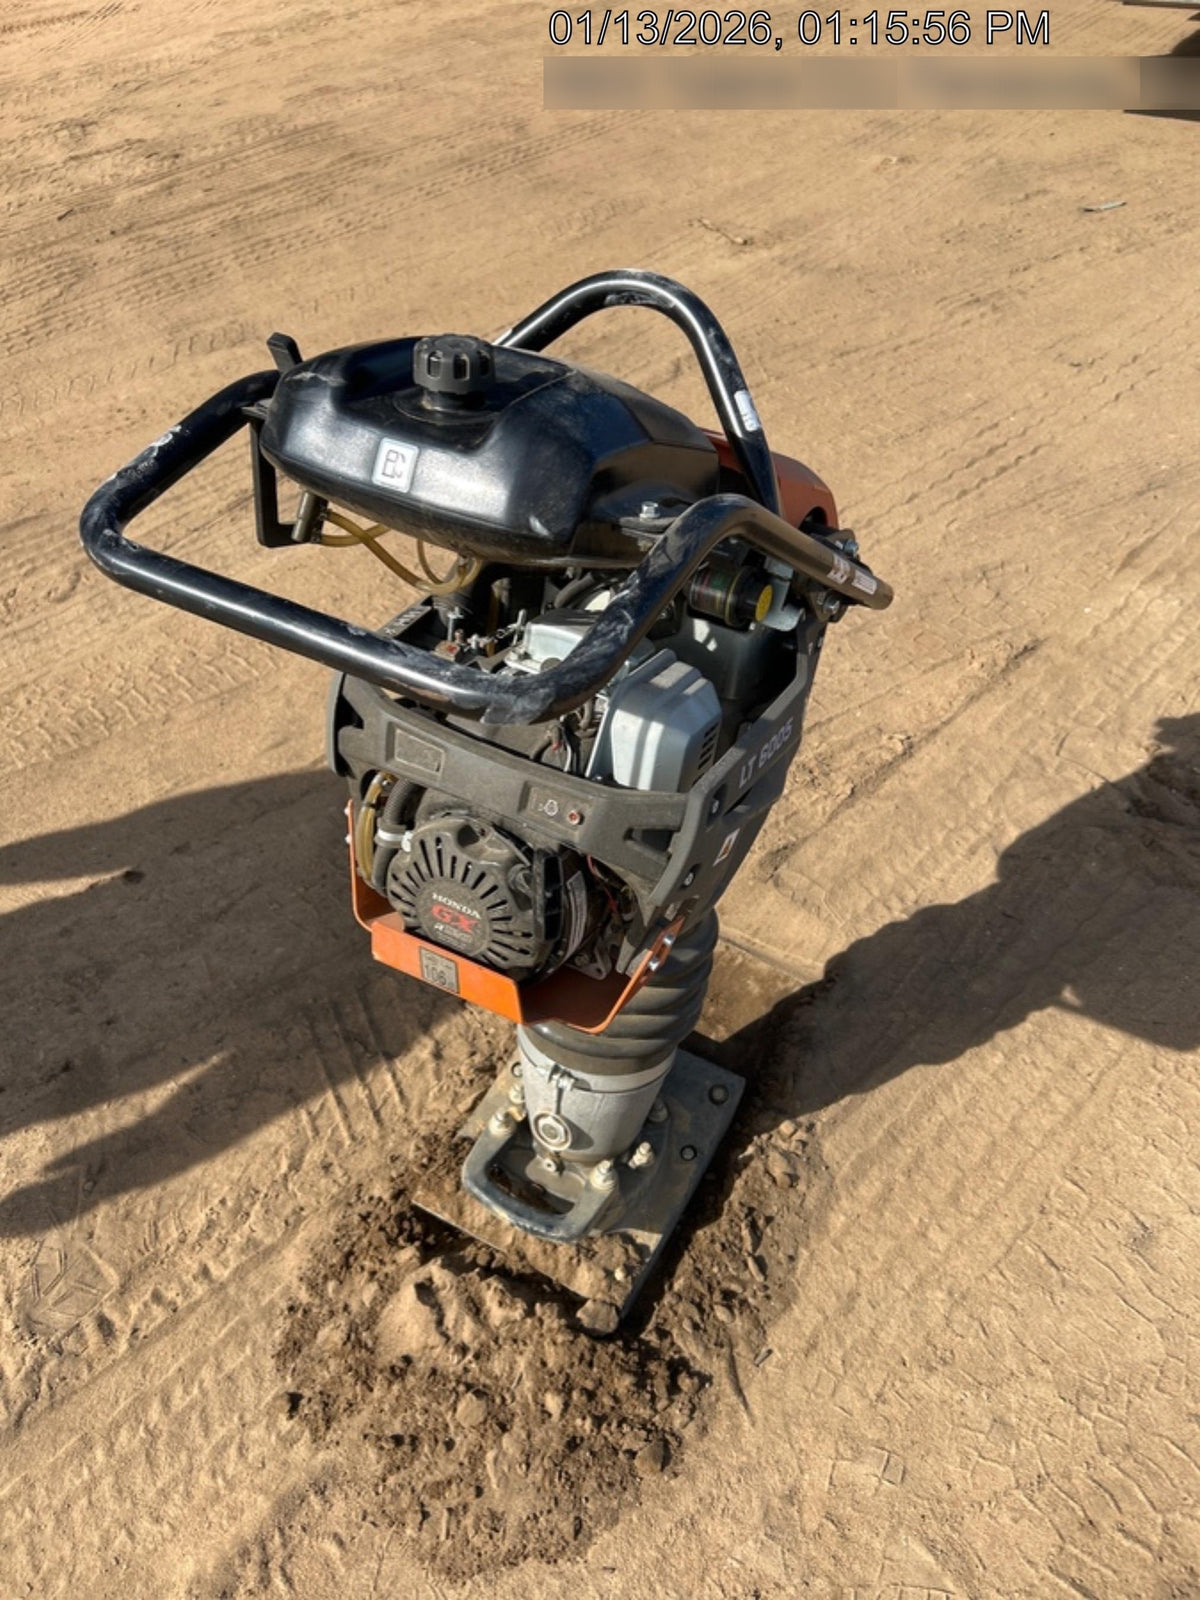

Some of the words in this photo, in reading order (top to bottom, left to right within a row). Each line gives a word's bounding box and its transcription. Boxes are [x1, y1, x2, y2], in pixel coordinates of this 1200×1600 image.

[739, 755, 757, 788] LT
[431, 903, 480, 936] GX
[432, 892, 481, 920] HONDA
